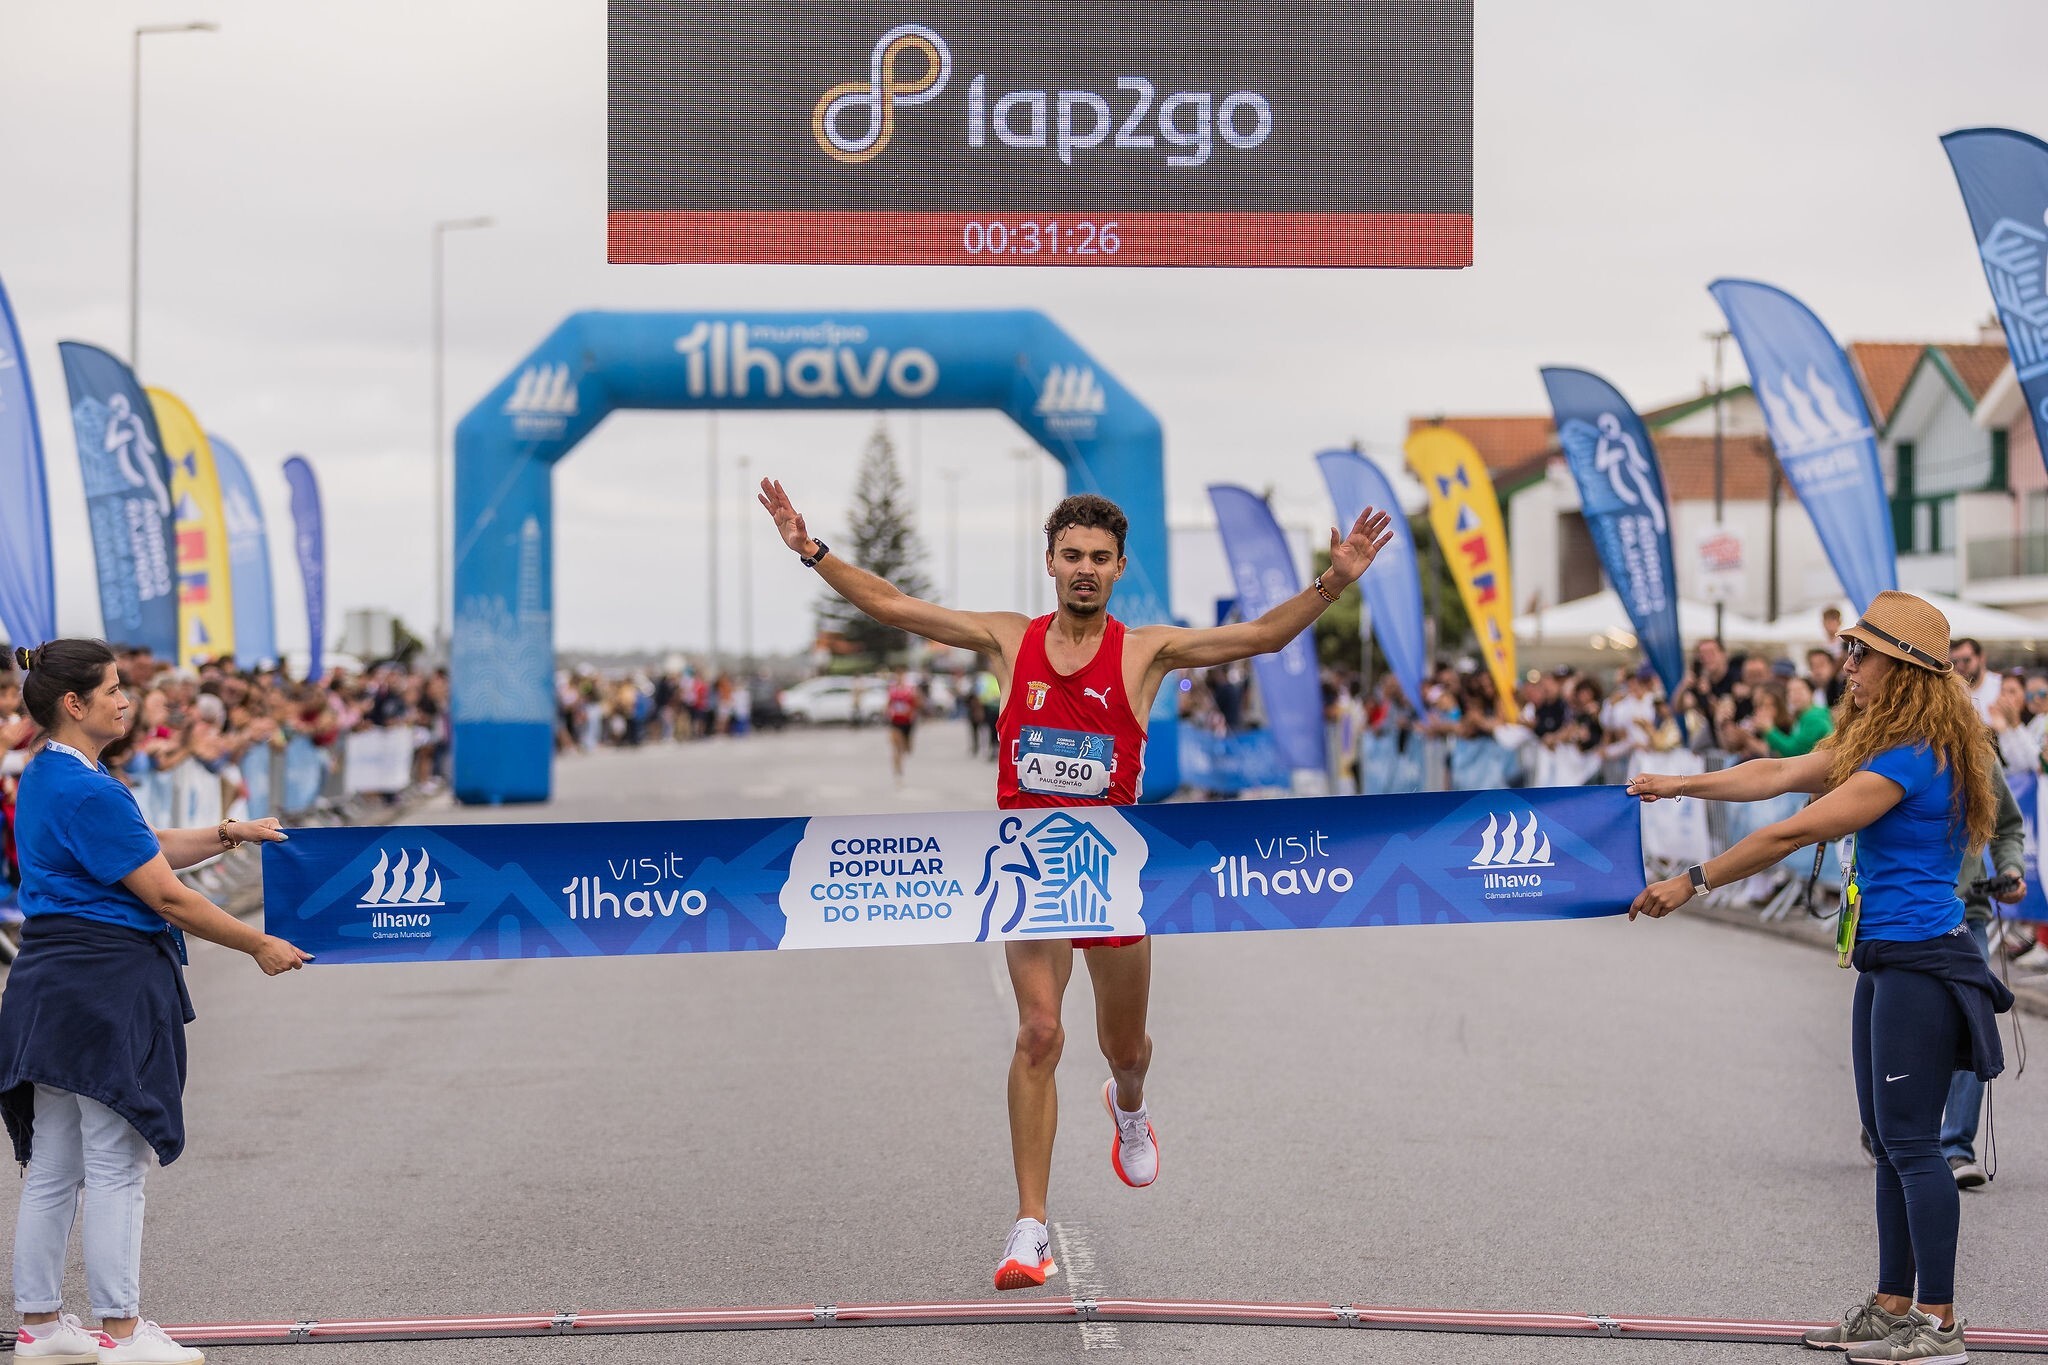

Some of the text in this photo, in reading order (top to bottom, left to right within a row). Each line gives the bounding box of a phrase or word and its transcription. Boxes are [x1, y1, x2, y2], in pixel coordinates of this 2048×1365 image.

[967, 74, 1273, 168] lap2go
[962, 221, 1122, 255] 00:31:26
[1027, 758, 1042, 774] A
[1055, 761, 1092, 780] 960
[830, 836, 941, 856] CORRIDA
[1255, 830, 1329, 864] visit
[608, 852, 683, 886] visit
[829, 858, 944, 878] POPULAR
[810, 879, 964, 902] COSTA NOVA
[1511, 890, 1543, 898] Municipal
[823, 902, 952, 923] DO PRADO
[372, 930, 432, 939] Câmara Municipal
